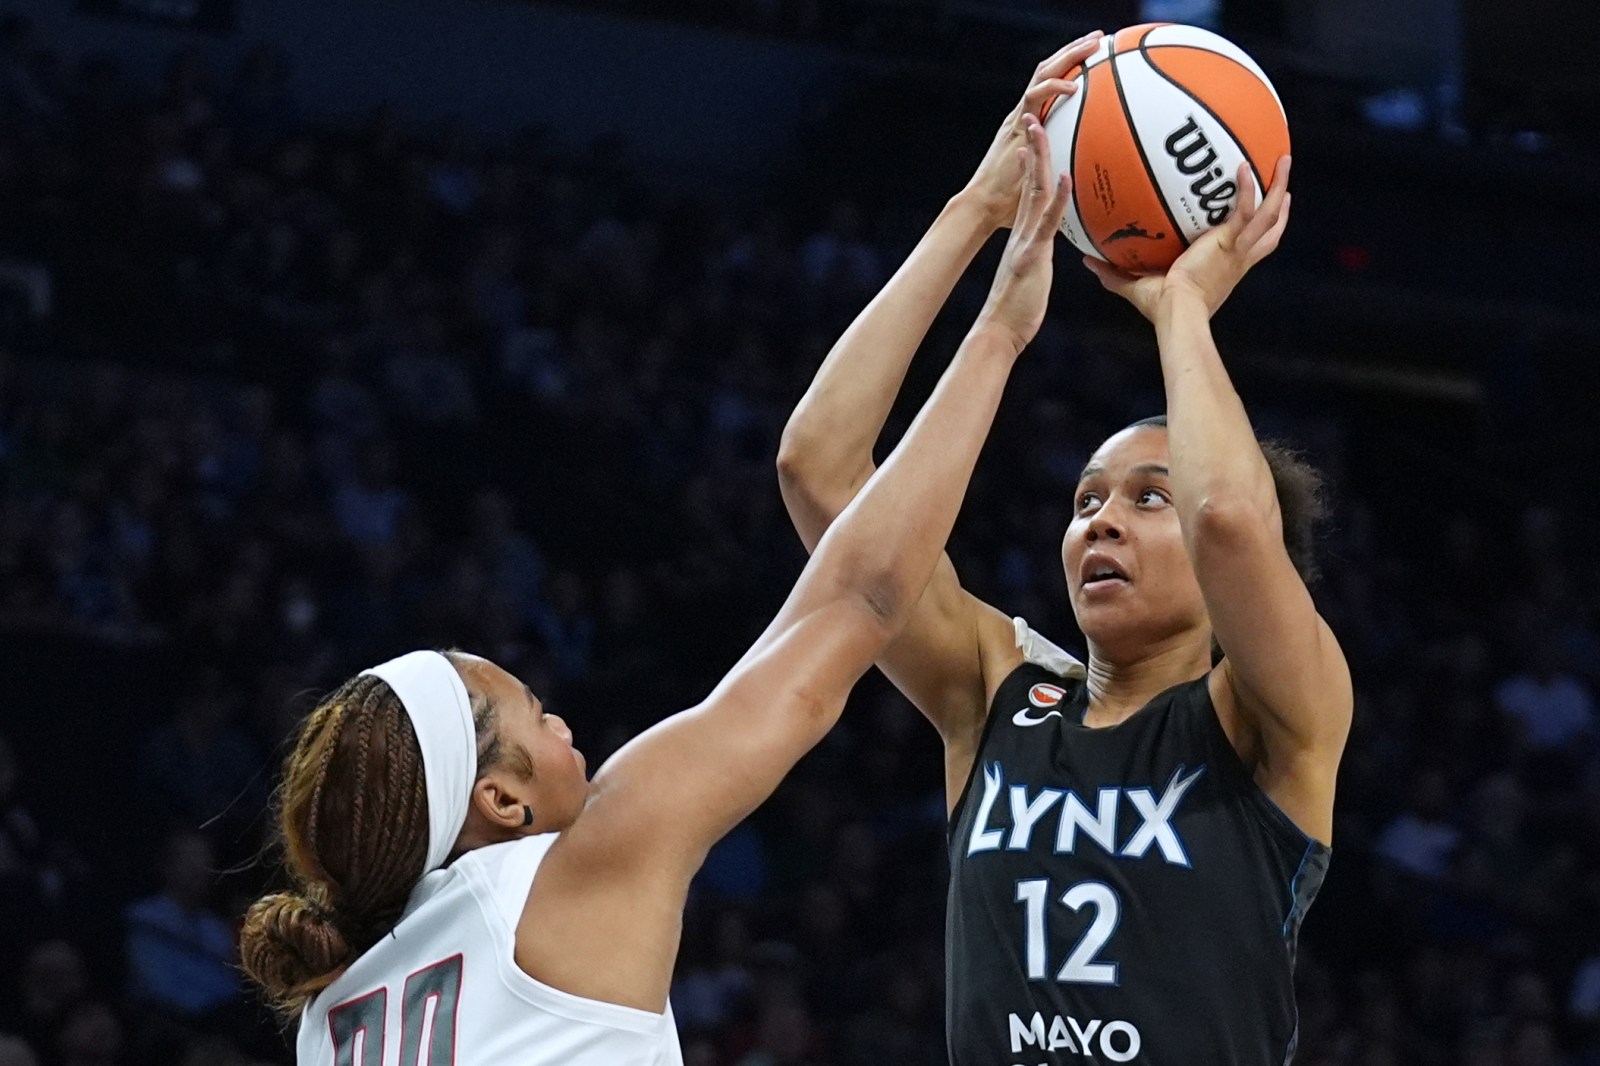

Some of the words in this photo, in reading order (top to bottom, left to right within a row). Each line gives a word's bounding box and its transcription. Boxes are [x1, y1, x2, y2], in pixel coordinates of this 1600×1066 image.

[1163, 114, 1237, 227] Wils
[1180, 196, 1192, 214] EVO
[967, 761, 1207, 869] LYNX
[1014, 877, 1122, 987] 12
[1008, 1011, 1141, 1062] MAYO
